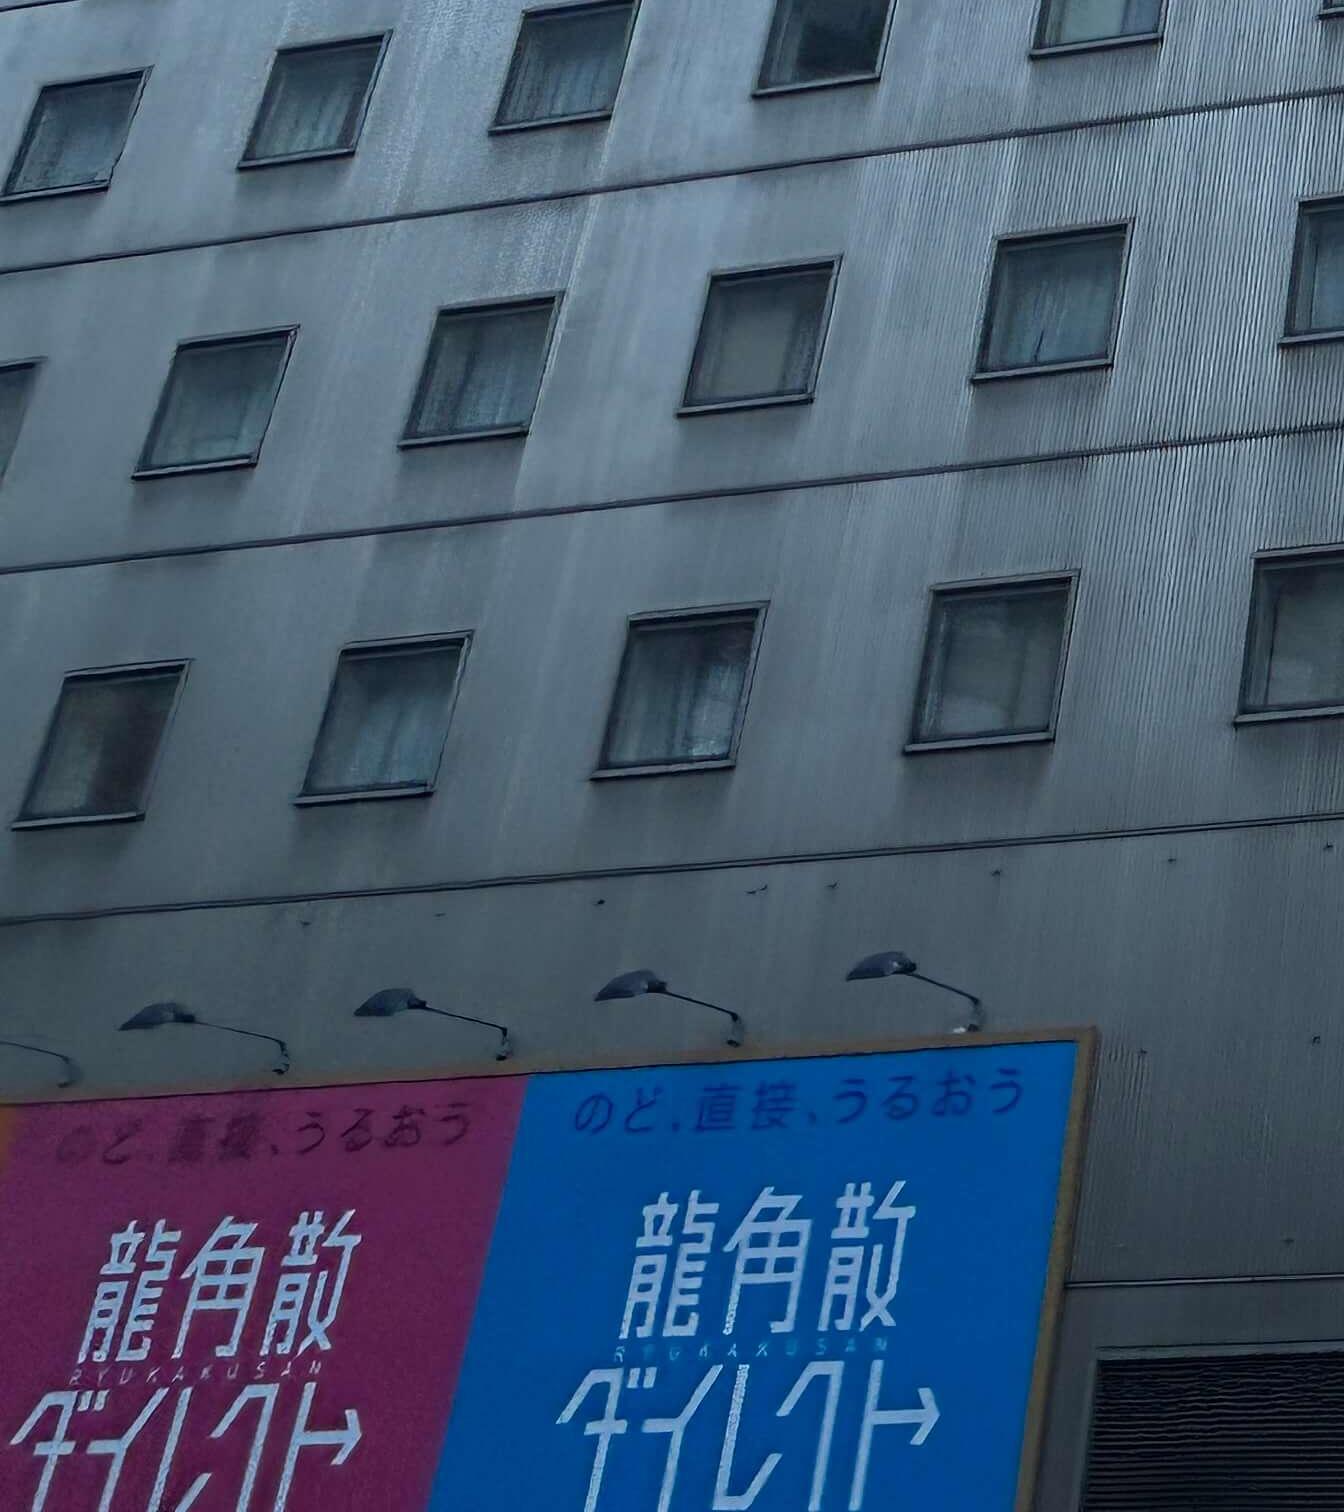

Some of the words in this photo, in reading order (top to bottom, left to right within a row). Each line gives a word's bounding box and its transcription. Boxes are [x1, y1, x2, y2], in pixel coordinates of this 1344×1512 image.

[76, 1207, 363, 1365] 龍角散
[617, 1179, 918, 1341] 龍角散
